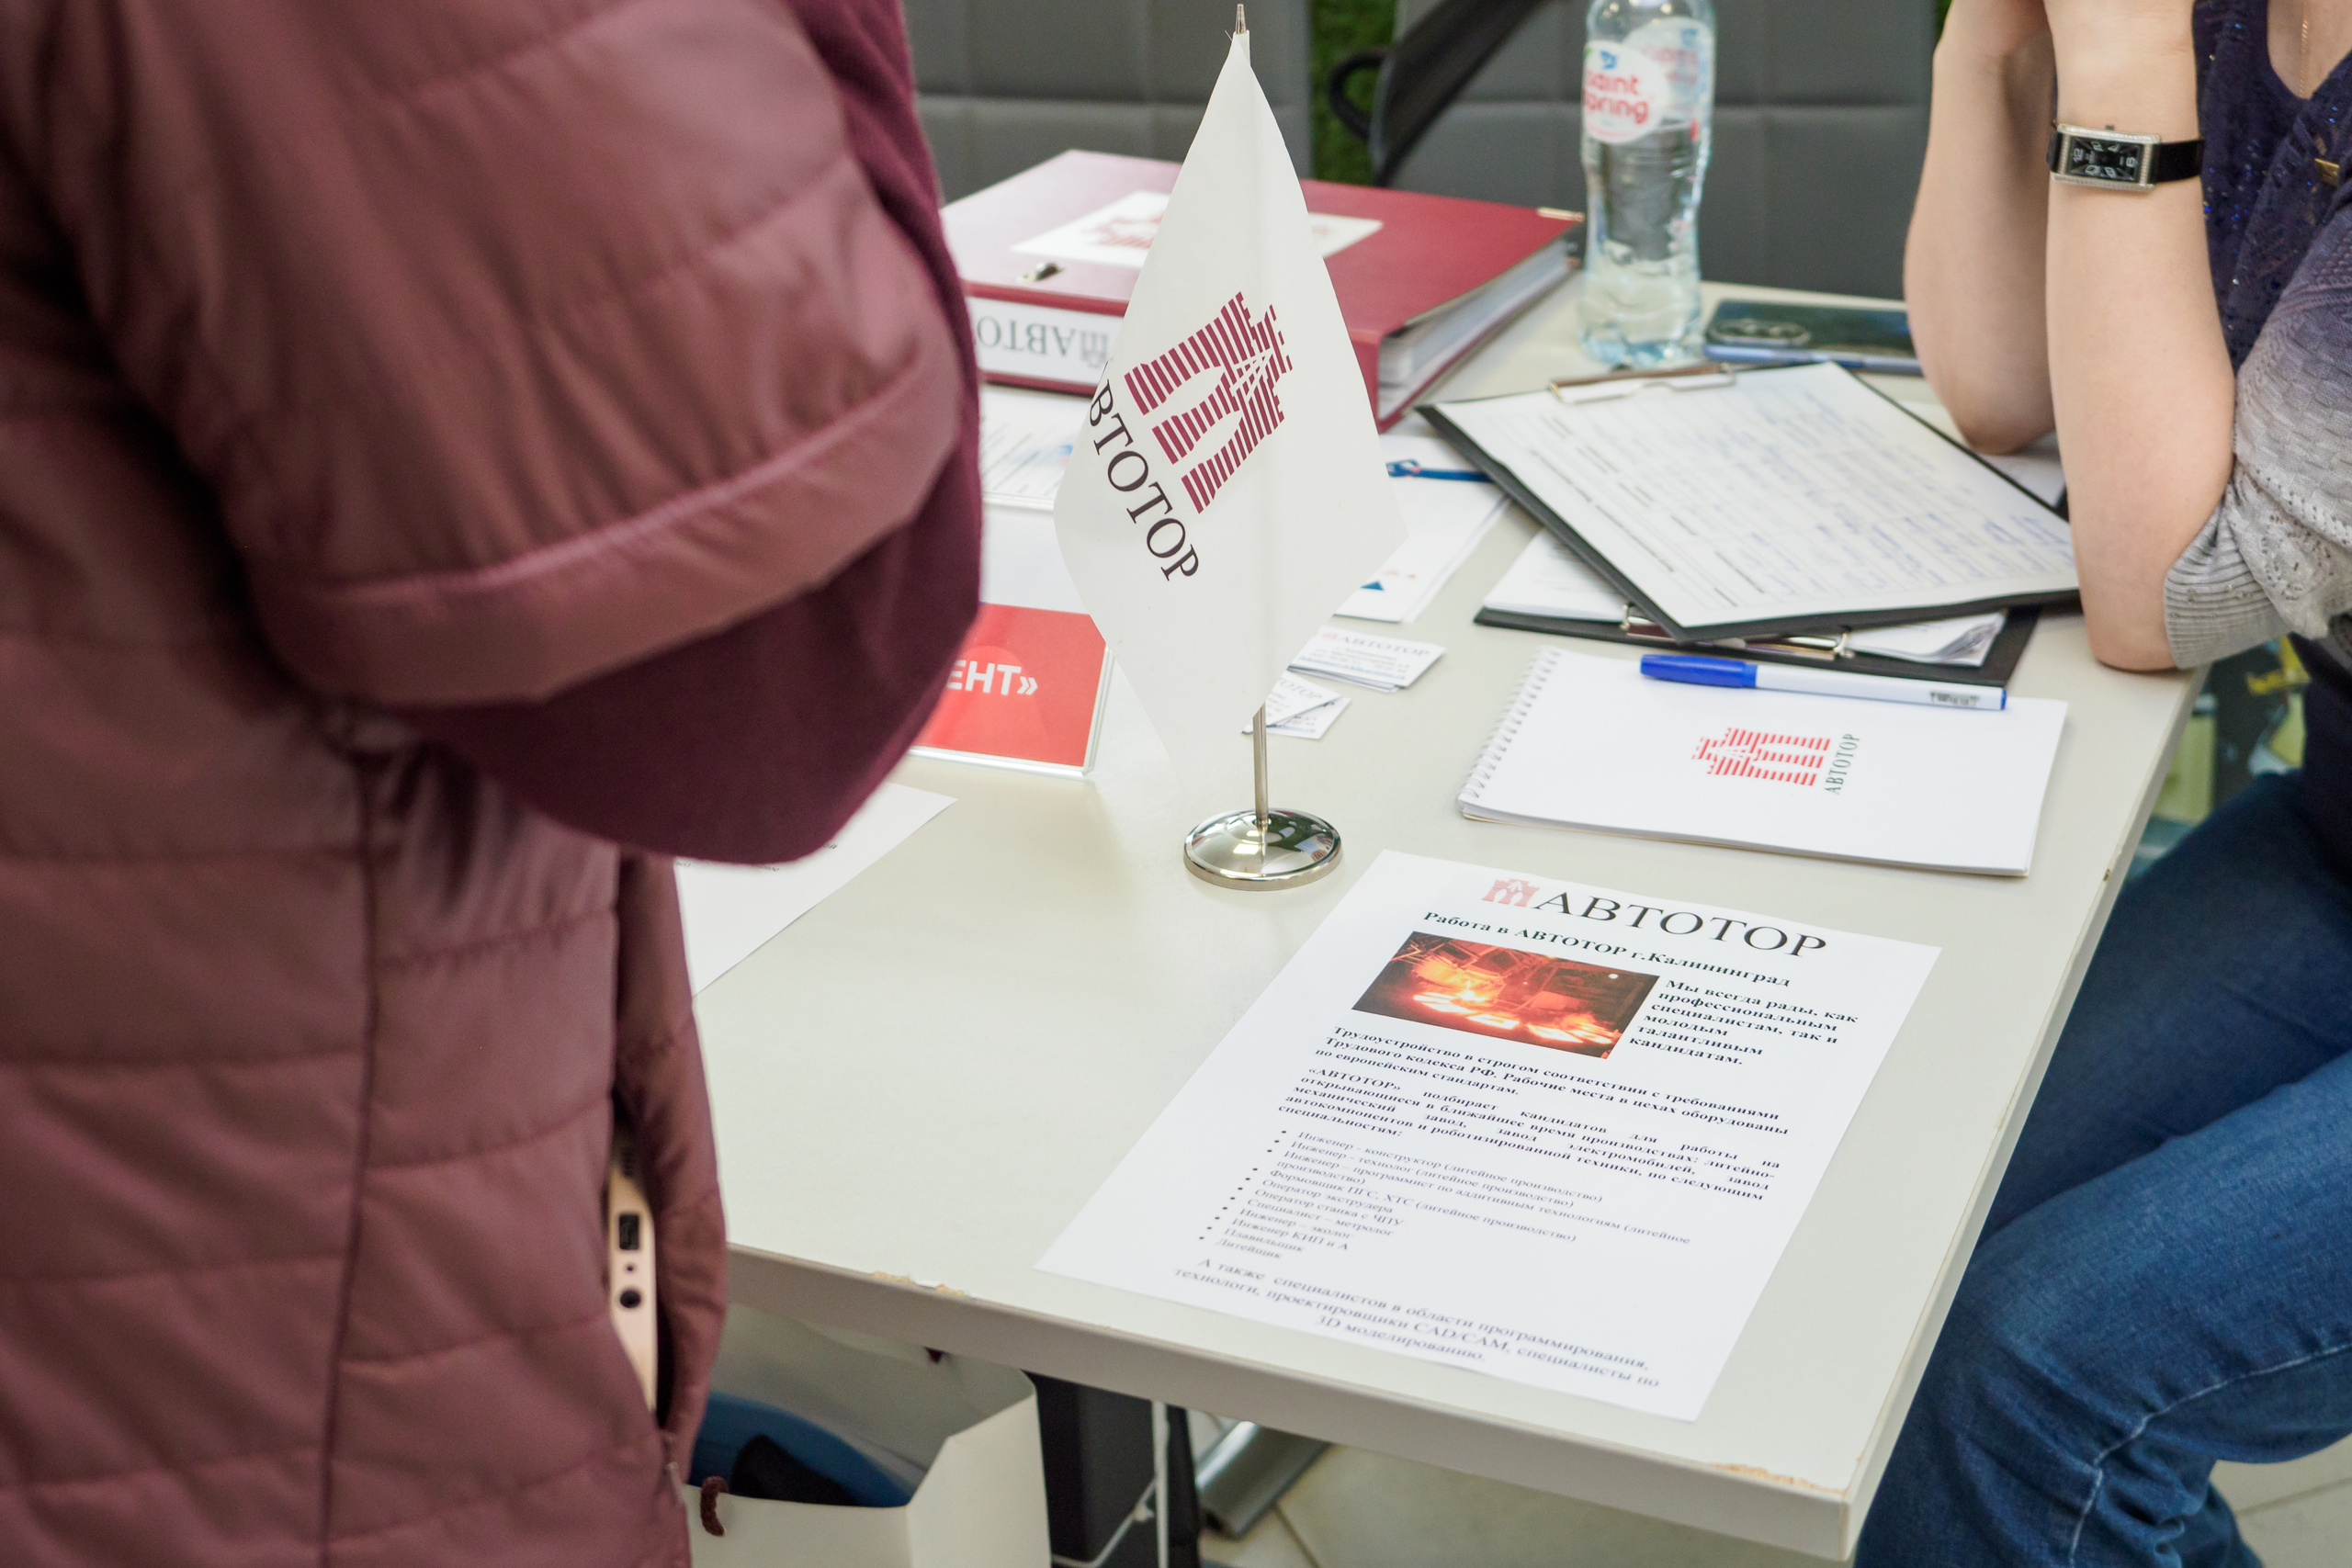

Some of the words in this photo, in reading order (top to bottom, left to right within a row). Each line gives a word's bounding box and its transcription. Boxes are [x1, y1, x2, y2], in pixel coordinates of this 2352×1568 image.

[1584, 70, 1640, 96] aint
[1089, 358, 1199, 581] ВТОТОР
[1337, 637, 1431, 656] АВТОТОР
[1824, 733, 1860, 795] АВТОТОР
[1532, 891, 1827, 958] АВТОТОР
[1423, 911, 1492, 933] Работа
[1499, 925, 1510, 934] в
[1514, 928, 1627, 956] АВТОТОР
[1631, 950, 1791, 987] г.Калининград
[1651, 1003, 1783, 1035] специалистам,
[1790, 1030, 1822, 1041] так
[1658, 992, 1838, 1032] профессиональным
[1666, 980, 1699, 993] Мы
[1704, 988, 1761, 1006] всегда
[1766, 999, 1817, 1017] рады,
[1824, 1012, 1859, 1023] как
[1636, 1026, 1763, 1055] талантливым
[1644, 1015, 1728, 1036] молодым
[1315, 1049, 1333, 1057] по
[1336, 1052, 1430, 1077] европейским
[1431, 1072, 1519, 1096] стандартам.
[1333, 1026, 1461, 1059] Трудоустройство
[1477, 1056, 1540, 1074] строгом
[1543, 1069, 1648, 1096] соответствии
[1664, 1093, 1781, 1121] требованиями
[1629, 1038, 1743, 1066] кандидатам.
[1325, 1036, 1403, 1059] Трудового
[1406, 1055, 1466, 1073] кодекса
[1470, 1066, 1498, 1079] РФ.
[1503, 1072, 1566, 1092] Рабочие
[1569, 1088, 1614, 1102] места
[1632, 1100, 1679, 1114] цехах
[1681, 1109, 1789, 1135] оборудованы
[1277, 1105, 1404, 1138] специальностям:
[1293, 1087, 1396, 1113] механический
[1423, 1112, 1467, 1128] завод,
[1496, 1127, 1538, 1142] завод
[1566, 1142, 1696, 1175] электромобилей,
[1725, 1176, 1770, 1191] завод
[1300, 1077, 1420, 1107] открывающиеся
[1440, 1104, 1526, 1129] ближайшее
[1529, 1123, 1577, 1139] время
[1580, 1134, 1700, 1165] производствах:
[1703, 1159, 1776, 1179] литейно-
[1308, 1066, 1401, 1091] «АВТОТОР»
[1422, 1089, 1499, 1112] подбирает
[1519, 1110, 1608, 1134] кандидатов
[1629, 1133, 1657, 1144] для
[1679, 1143, 1738, 1161] работы
[1761, 1159, 1781, 1168] на
[1284, 1095, 1415, 1128] автокомпонентов
[1417, 1122, 1428, 1131] и
[1430, 1125, 1572, 1160] роботизированной
[1577, 1156, 1643, 1177] техники,
[1647, 1170, 1668, 1182] по
[1670, 1175, 1764, 1201] следующим
[1297, 1132, 1354, 1151] Инженер
[1364, 1147, 1442, 1169] конструктор
[1443, 1162, 1508, 1183] (литейное
[1510, 1178, 1603, 1203] производство)
[1262, 1179, 1321, 1200] Оператор
[1325, 1194, 1394, 1215] экструдера
[1277, 1161, 1366, 1186] производство)
[1291, 1141, 1347, 1160] Инженер
[1358, 1156, 1414, 1174] технолог
[1415, 1168, 1479, 1188] (литейное
[1482, 1182, 1575, 1209] производство)
[1247, 1198, 1322, 1220] Специалист
[1335, 1218, 1395, 1237] метролог
[1255, 1189, 1314, 1209] Оператор
[1317, 1203, 1358, 1218] станка
[1374, 1213, 1405, 1226] ЧПУ
[1271, 1170, 1344, 1192] Формовщик
[1385, 1193, 1414, 1206] ХТС
[1416, 1201, 1480, 1221] (литейное
[1482, 1216, 1577, 1242] производство)
[1283, 1151, 1340, 1170] Инженер
[1353, 1168, 1436, 1190] программист
[1437, 1185, 1453, 1194] по
[1538, 1206, 1622, 1229] технологиям
[1623, 1224, 1691, 1245] (литейное
[1224, 1227, 1306, 1253] Плавильщик
[1232, 1218, 1289, 1237] Инженер
[1239, 1208, 1296, 1228] Инженер
[1310, 1226, 1354, 1240] эколог
[1197, 1258, 1212, 1269] А
[1216, 1262, 1265, 1280] также
[1273, 1277, 1387, 1309] специалистов
[1392, 1303, 1402, 1312] в
[1406, 1306, 1474, 1328] области
[1266, 1290, 1409, 1329] проектировщики
[1517, 1347, 1633, 1382] специалисты
[1637, 1377, 1660, 1388] по
